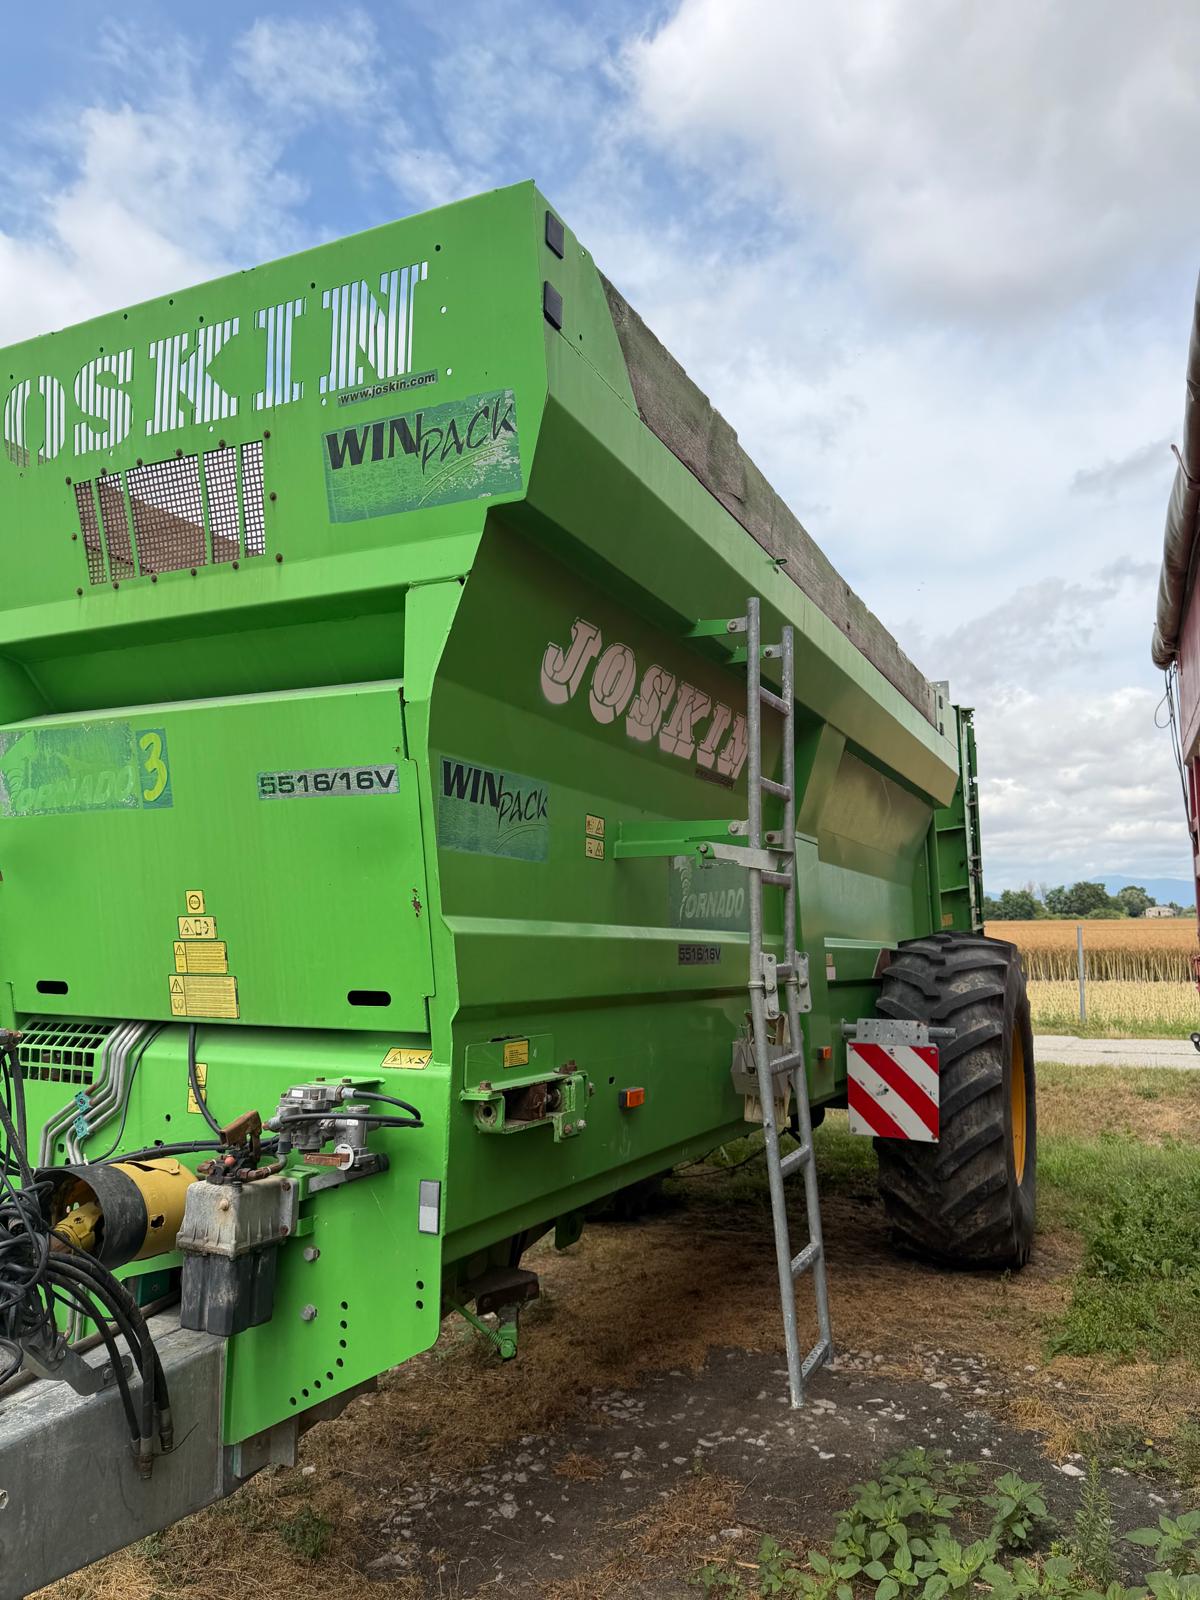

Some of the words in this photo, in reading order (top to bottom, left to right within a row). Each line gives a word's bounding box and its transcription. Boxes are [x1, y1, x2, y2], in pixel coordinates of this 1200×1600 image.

[340, 373, 436, 405] www.joskin.com
[139, 732, 168, 801] 3
[260, 769, 396, 794] 5516/16V
